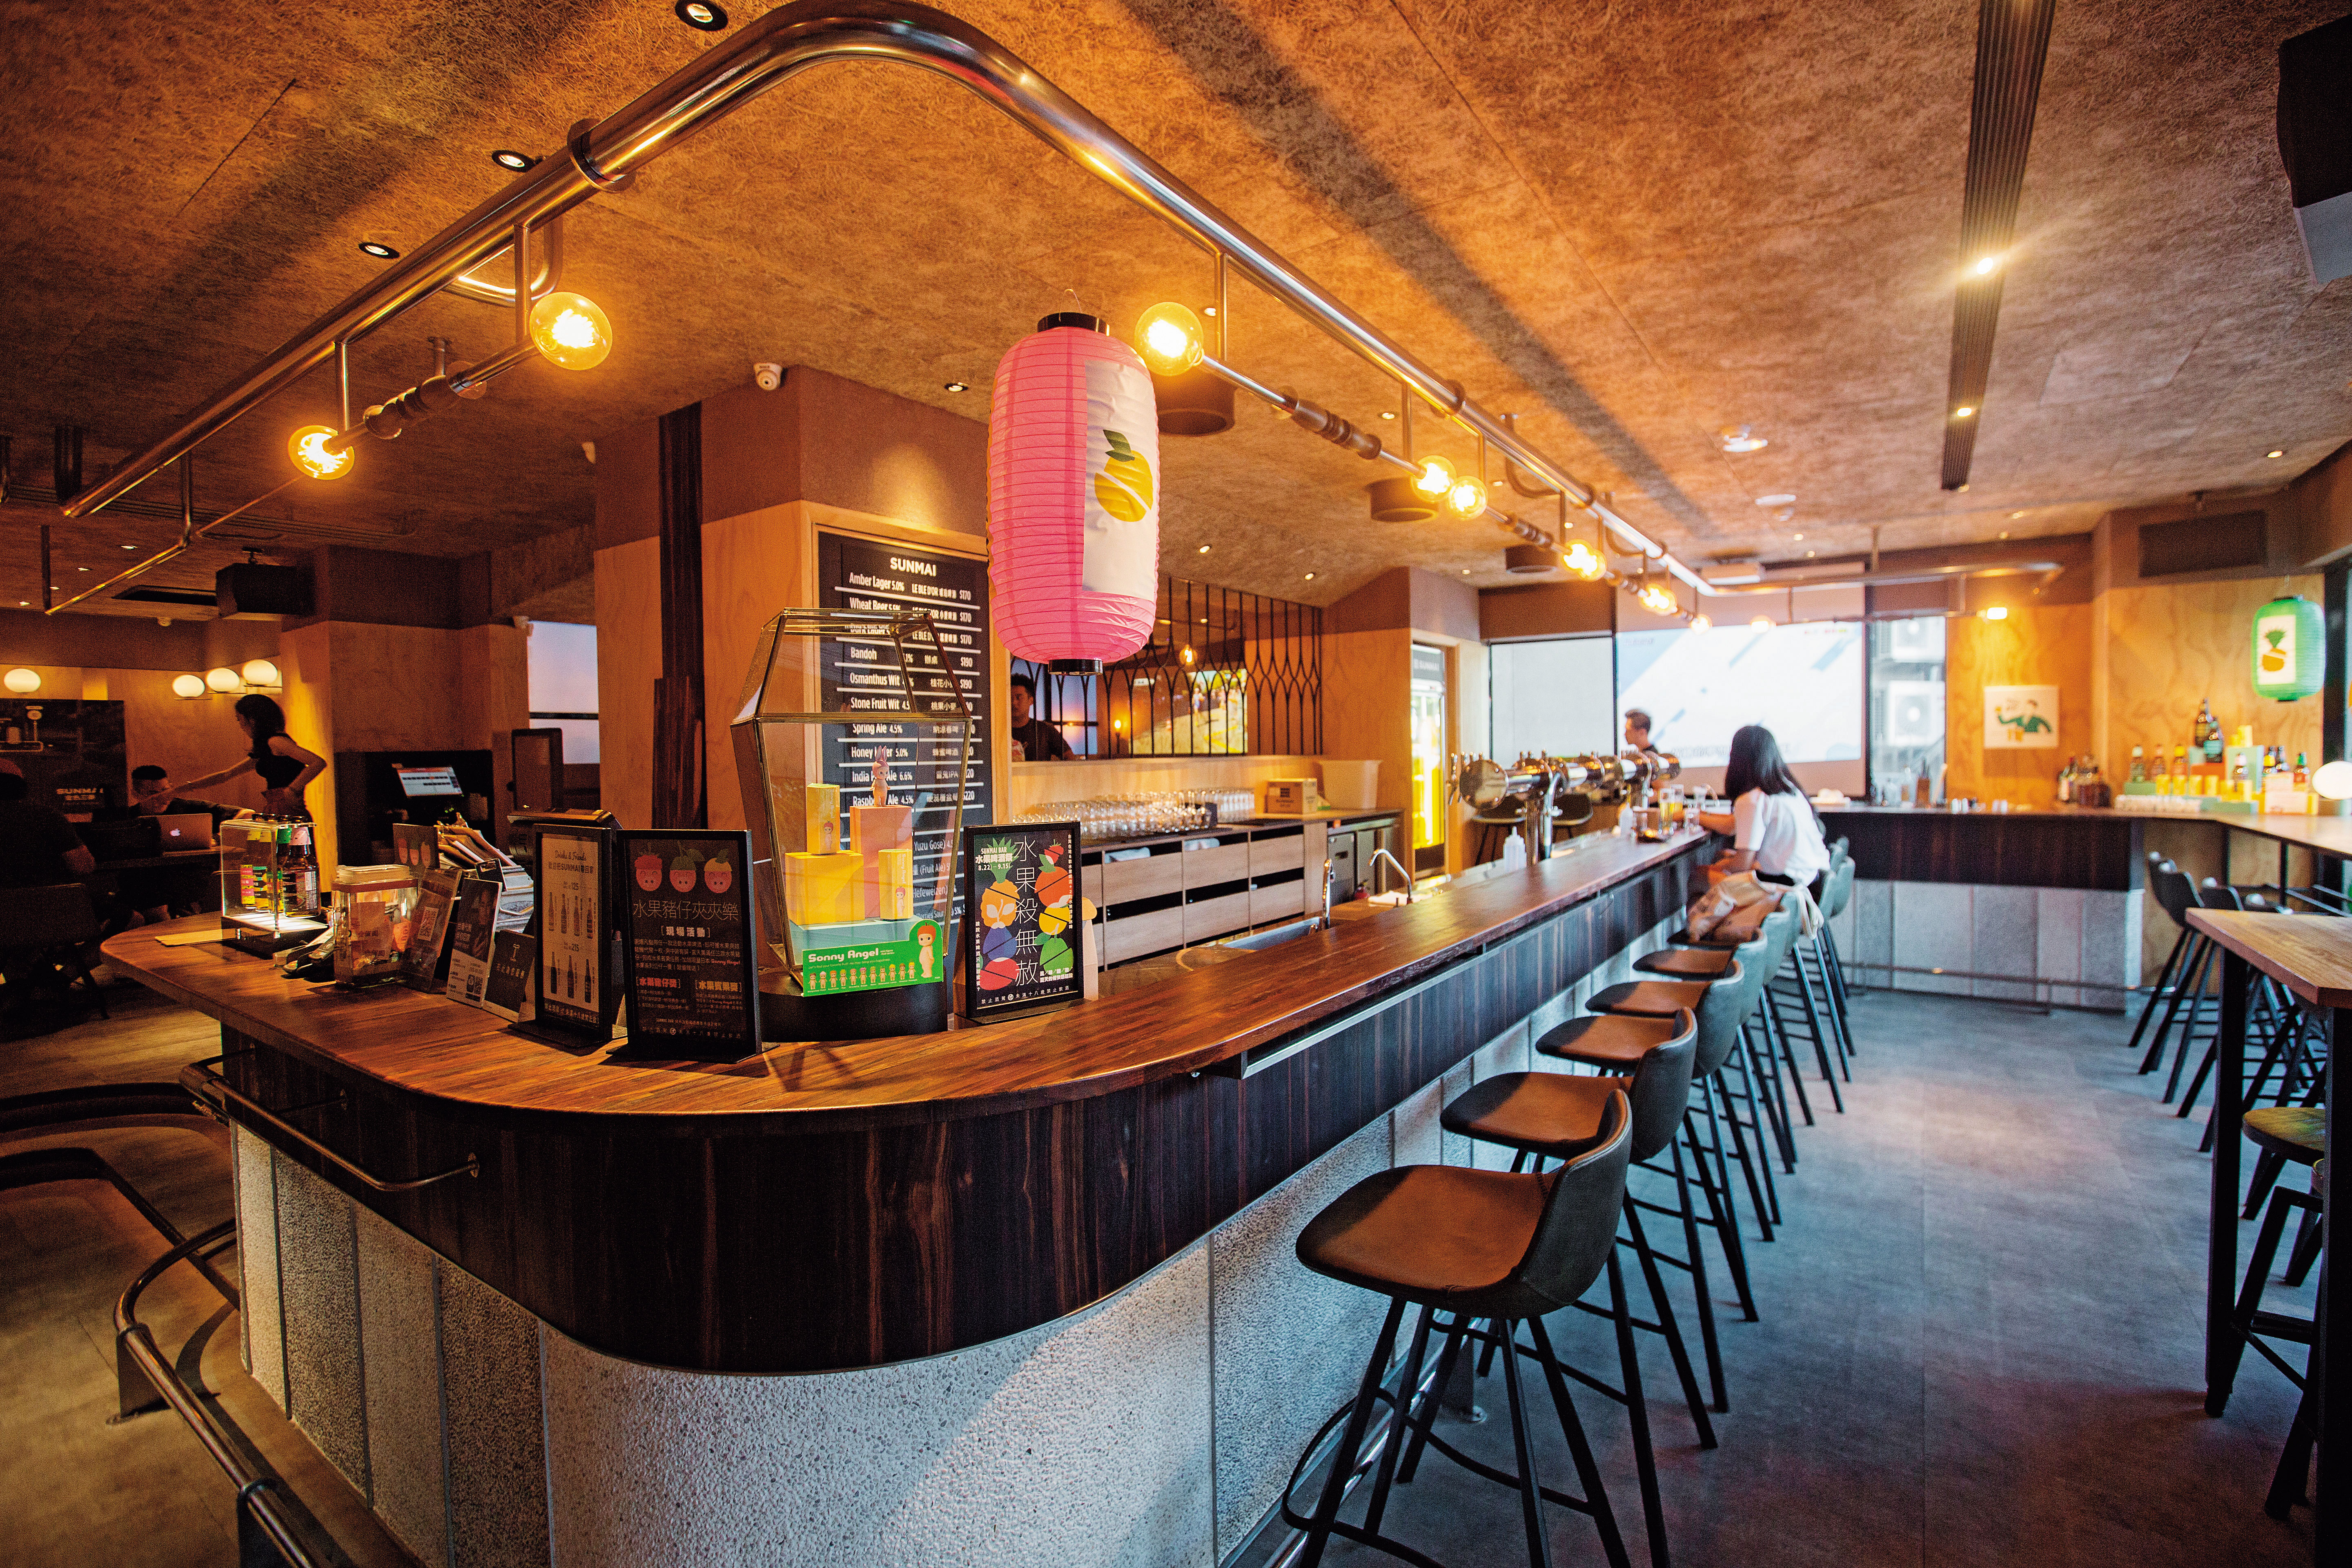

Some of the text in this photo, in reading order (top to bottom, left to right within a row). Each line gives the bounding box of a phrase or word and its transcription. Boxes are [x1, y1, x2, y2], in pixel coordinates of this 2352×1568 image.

[890, 557, 936, 577] SUNMAI
[849, 572, 872, 586] Amber
[873, 575, 891, 590] Lager
[891, 580, 905, 592] 5.0%
[912, 583, 918, 594] LE
[918, 584, 927, 595] BLE
[960, 589, 971, 601] $170
[849, 597, 872, 610] Wheat
[873, 599, 888, 610] Beer
[960, 612, 972, 623] $170
[918, 631, 927, 641] BLE
[960, 634, 972, 645] $170
[851, 647, 877, 660] Bandoh
[960, 657, 973, 668] $190
[850, 673, 888, 686] Osmanthus
[888, 674, 900, 686] Wit
[960, 679, 973, 689] $190
[851, 697, 870, 709] Stone
[871, 698, 887, 710] Fruit
[888, 698, 900, 710] Wit
[853, 723, 875, 735] Spring
[876, 724, 887, 733] Ale
[889, 724, 903, 734] 4.5%
[851, 746, 873, 759] Honey
[895, 748, 909, 757] 5.0%
[852, 771, 870, 782] India
[900, 772, 913, 781] 6.6%
[888, 794, 898, 805] Ale
[901, 795, 914, 804] 4.5%
[914, 841, 928, 851] Yuzu
[929, 839, 945, 850] Gose)
[976, 853, 1013, 864] 水果啤酒祭
[935, 864, 945, 873] Ale)
[633, 899, 738, 921] 水果豬仔夾夾樂
[1014, 836, 1038, 986] 水果殺無赦
[808, 953, 844, 962] Sonny
[848, 948, 879, 960] Angel
